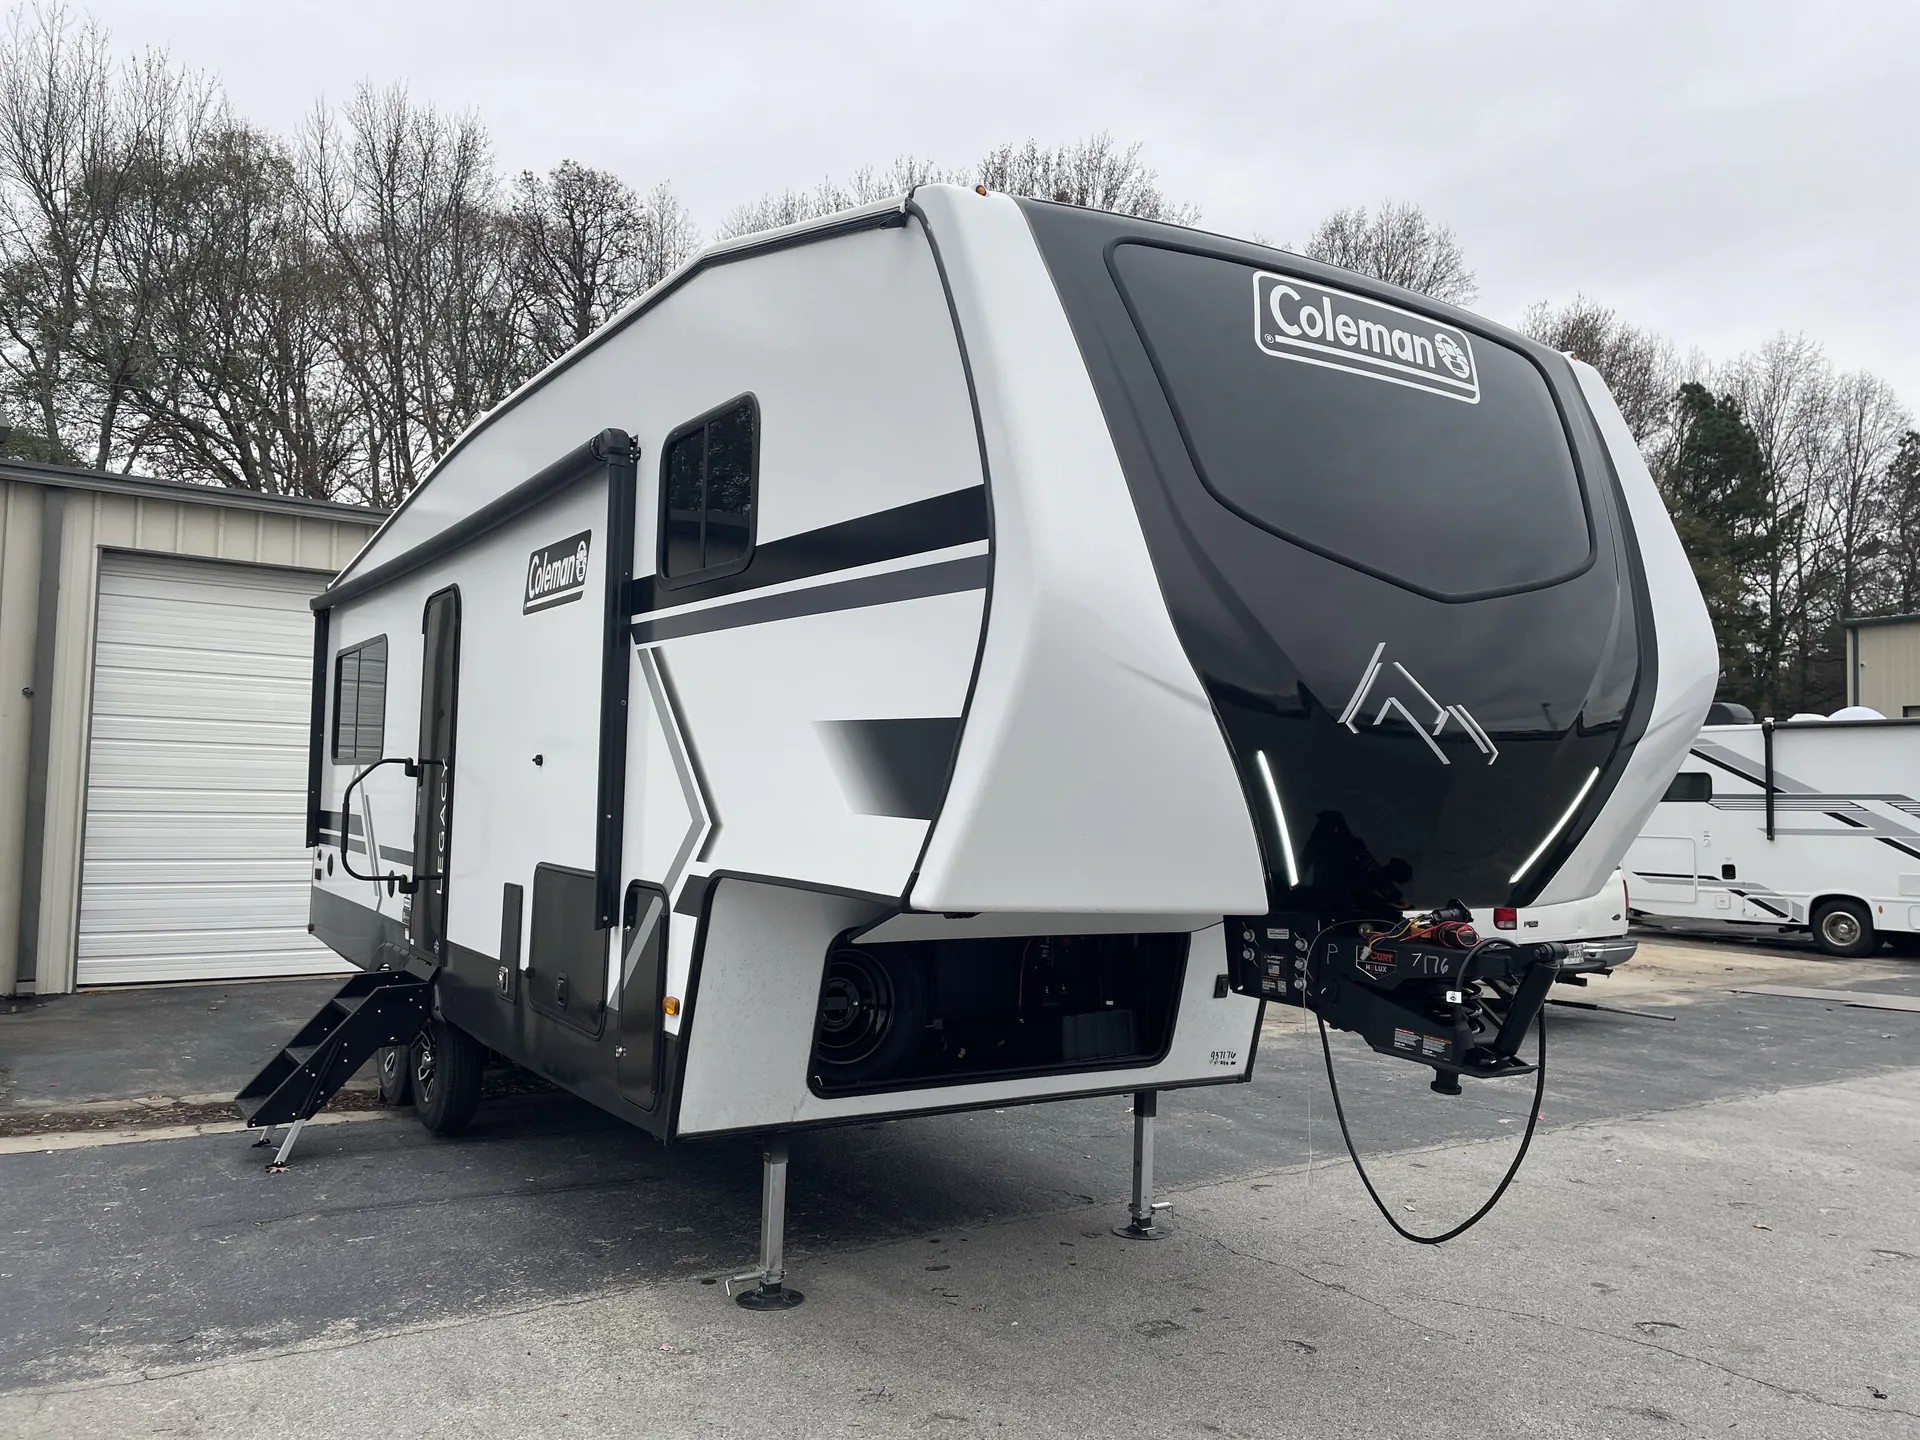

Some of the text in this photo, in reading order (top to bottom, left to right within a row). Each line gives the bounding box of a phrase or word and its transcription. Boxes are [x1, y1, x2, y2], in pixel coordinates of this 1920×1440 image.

[1269, 284, 1436, 369] Coleman
[528, 551, 576, 599] Coleman
[436, 758, 448, 895] LEGACY
[1326, 943, 1339, 964] P
[1365, 963, 1388, 973] HELUX
[1370, 951, 1394, 963] CURT
